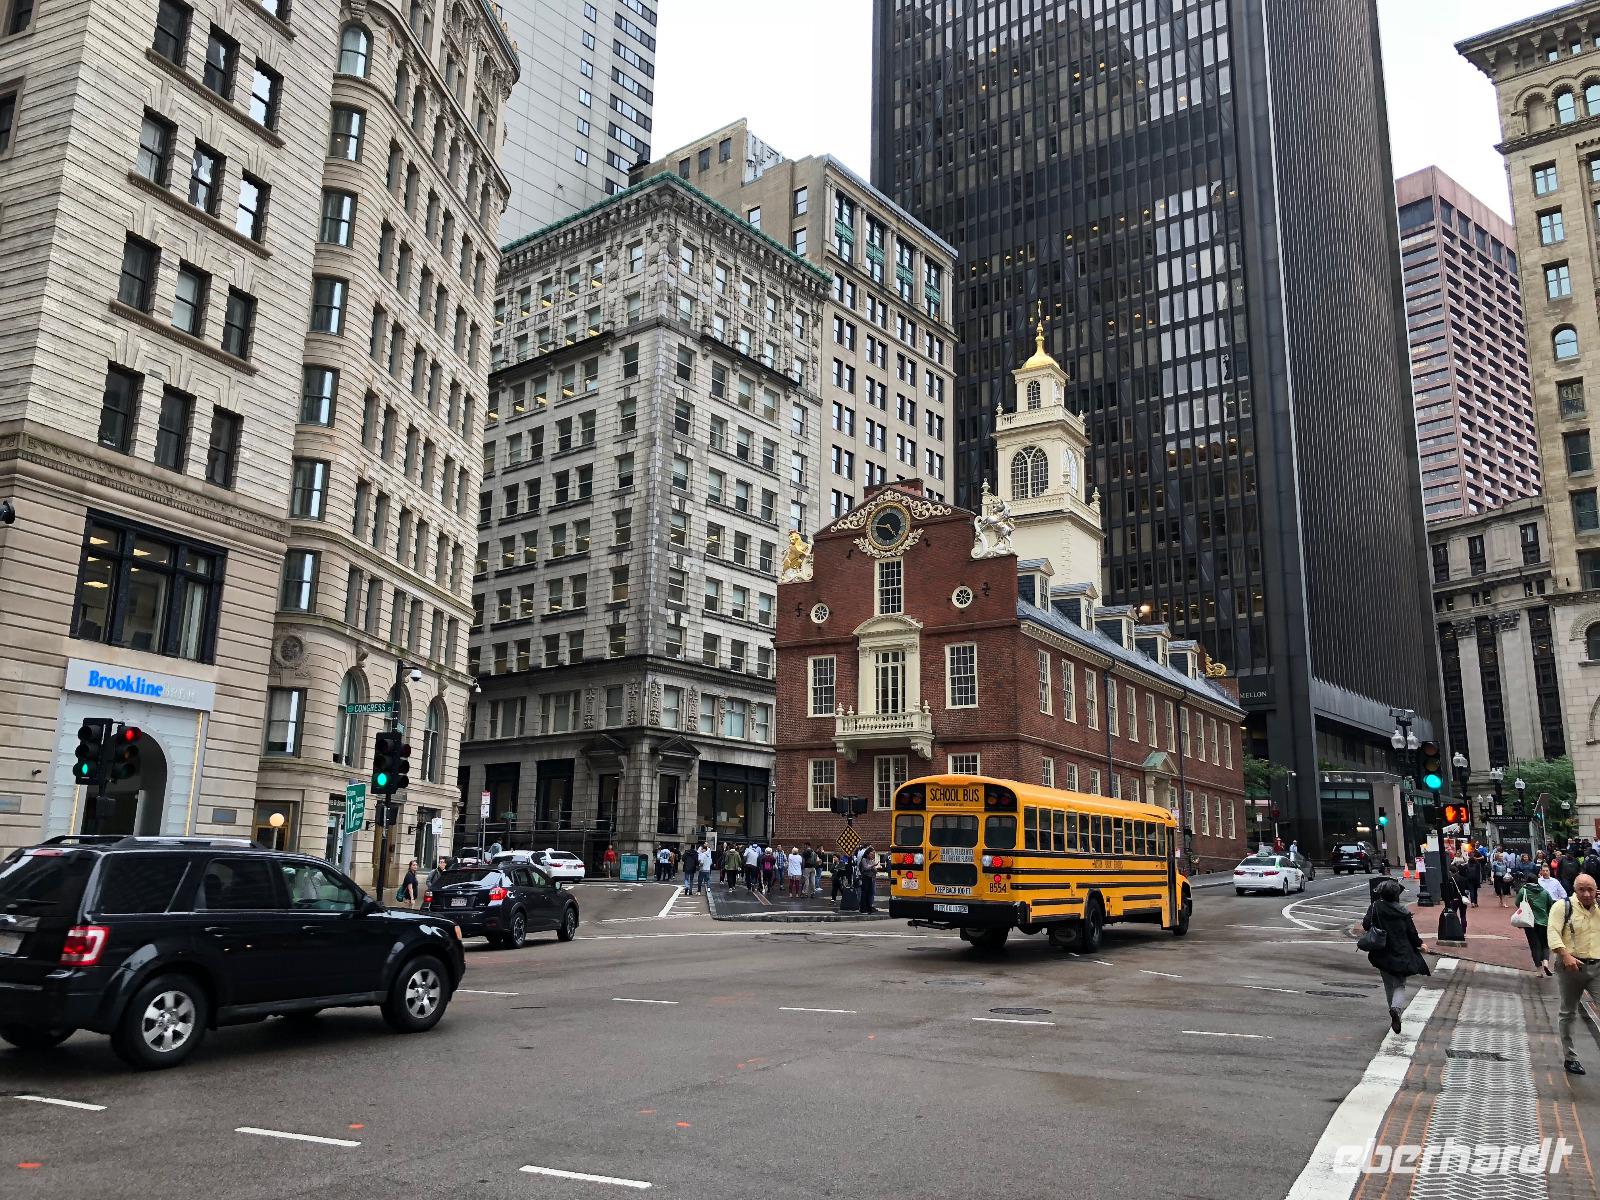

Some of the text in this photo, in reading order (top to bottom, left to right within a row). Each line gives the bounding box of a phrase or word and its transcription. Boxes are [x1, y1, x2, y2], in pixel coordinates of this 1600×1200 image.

[88, 670, 163, 697] Brookline
[354, 703, 386, 713] CONGRESS
[930, 788, 980, 802] SCHOOL BUS
[1459, 807, 1467, 822] 3
